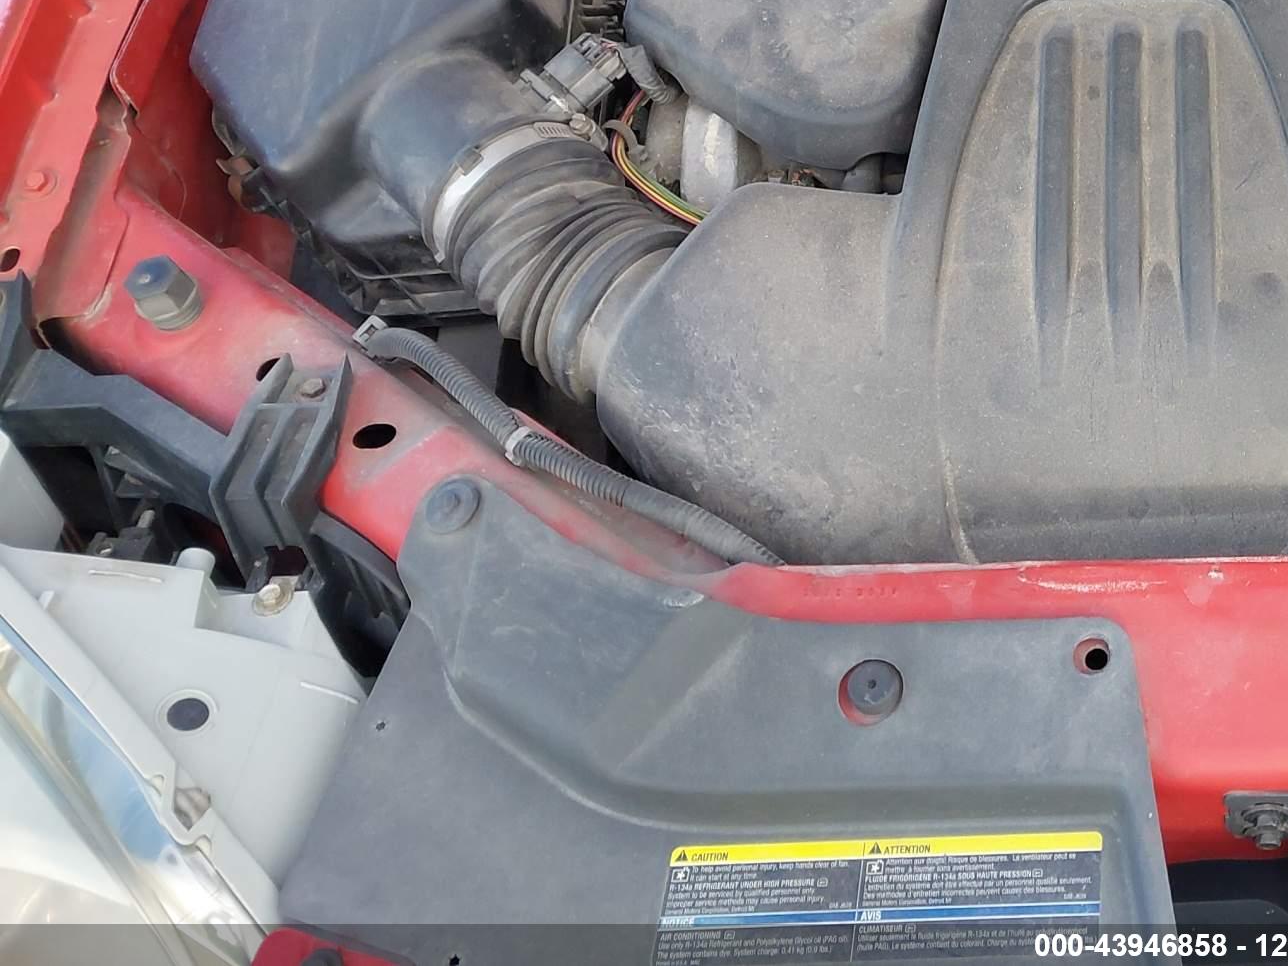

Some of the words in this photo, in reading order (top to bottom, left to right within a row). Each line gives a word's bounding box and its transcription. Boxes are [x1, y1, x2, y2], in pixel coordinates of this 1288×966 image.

[884, 843, 931, 855] ATTENTION
[691, 851, 729, 862] CAUTION
[977, 871, 998, 879] HAUTE
[1000, 870, 1031, 878] PRESSION
[694, 881, 739, 891] REFRIGERANT
[740, 880, 763, 889] UNDER
[781, 878, 814, 887] PRESSURE
[860, 911, 882, 921] AVIS
[662, 917, 694, 929] NOTICE
[859, 925, 903, 934] CLIMATISEUR
[660, 933, 672, 942] AIR
[673, 931, 721, 941] CONDITIONING
